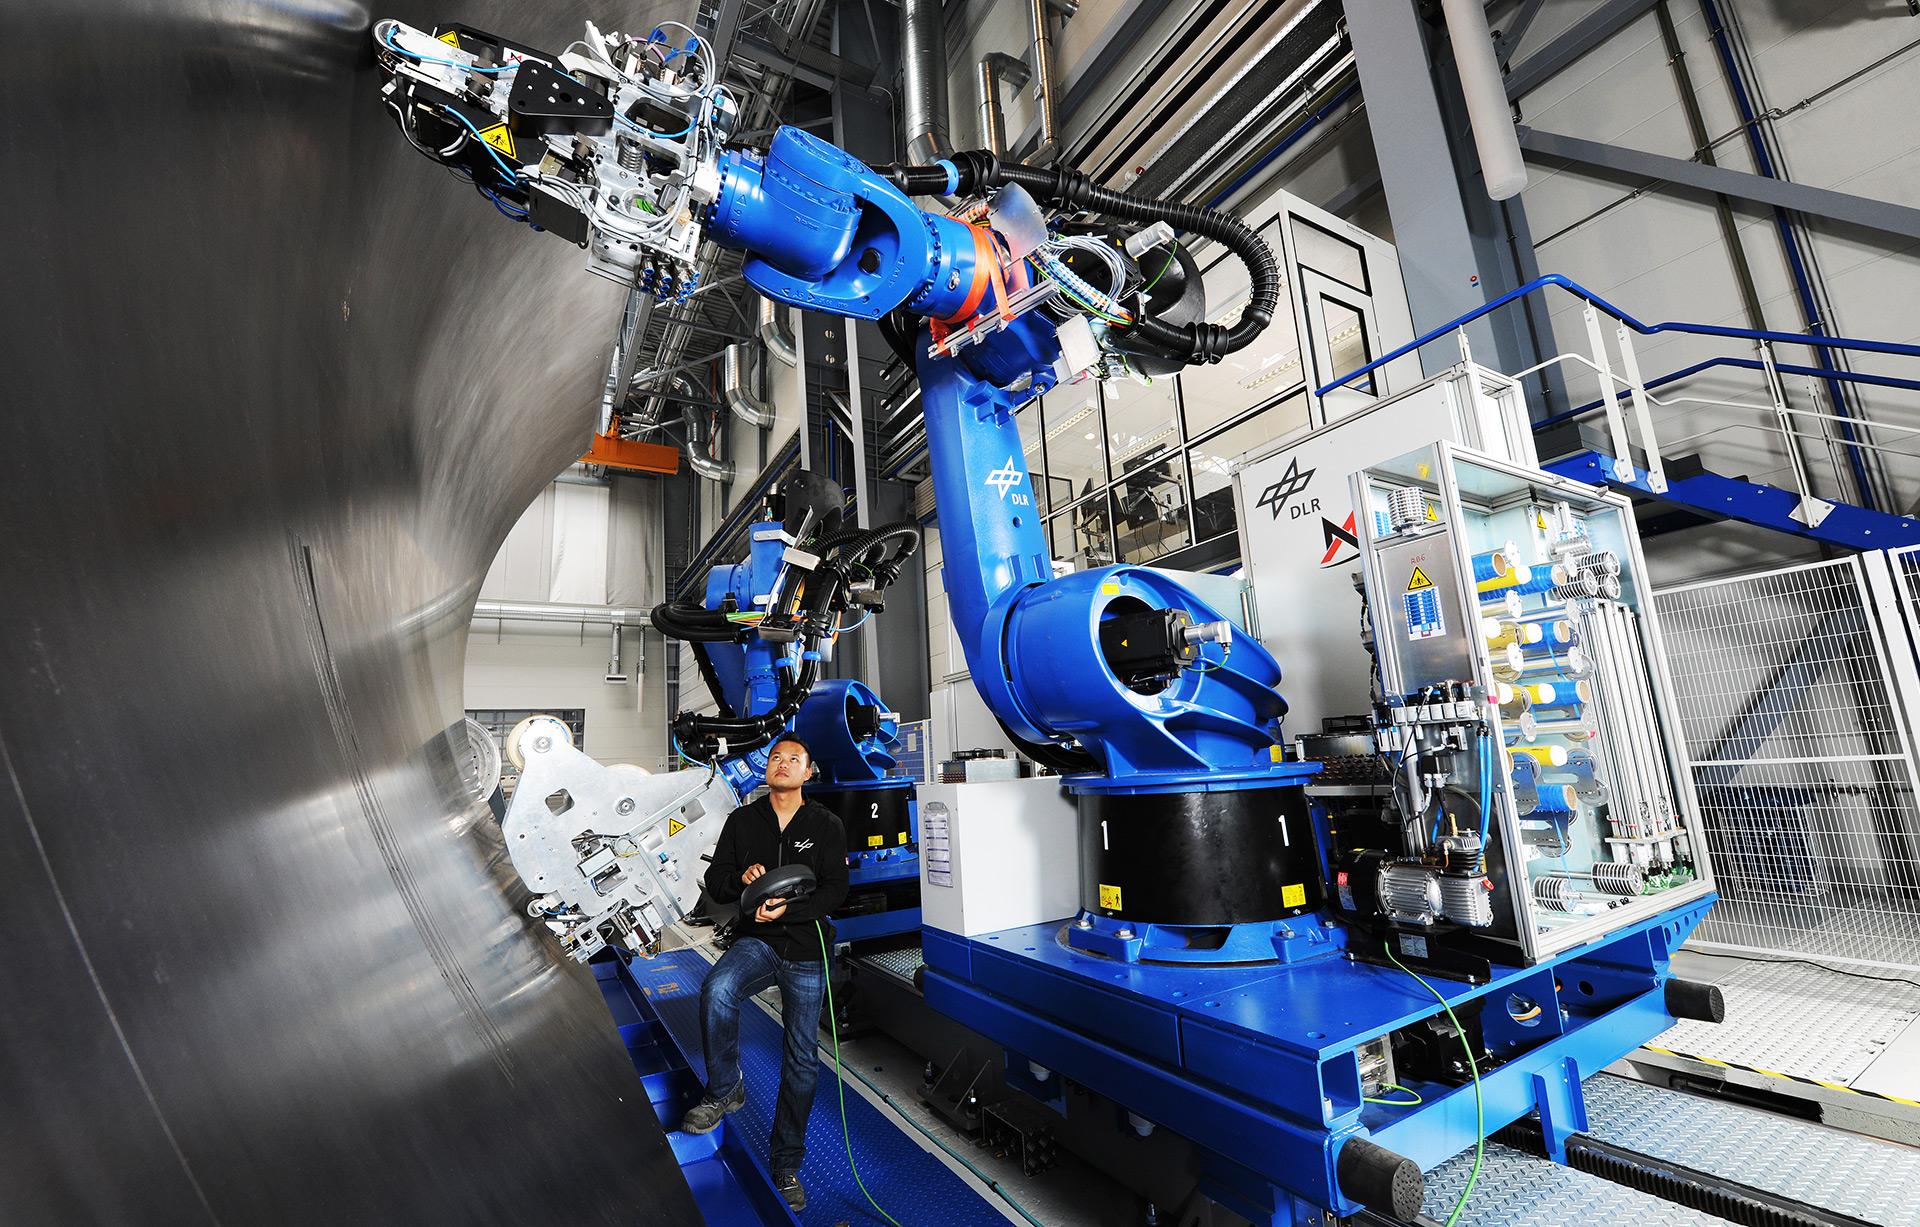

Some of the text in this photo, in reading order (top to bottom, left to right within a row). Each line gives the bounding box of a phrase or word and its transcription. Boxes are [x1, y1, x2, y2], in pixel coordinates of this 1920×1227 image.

[1011, 493, 1029, 506] DLR
[1290, 498, 1321, 520] DLR
[871, 802, 879, 819] 2
[1101, 820, 1109, 850] 1
[1278, 814, 1290, 847] 1
